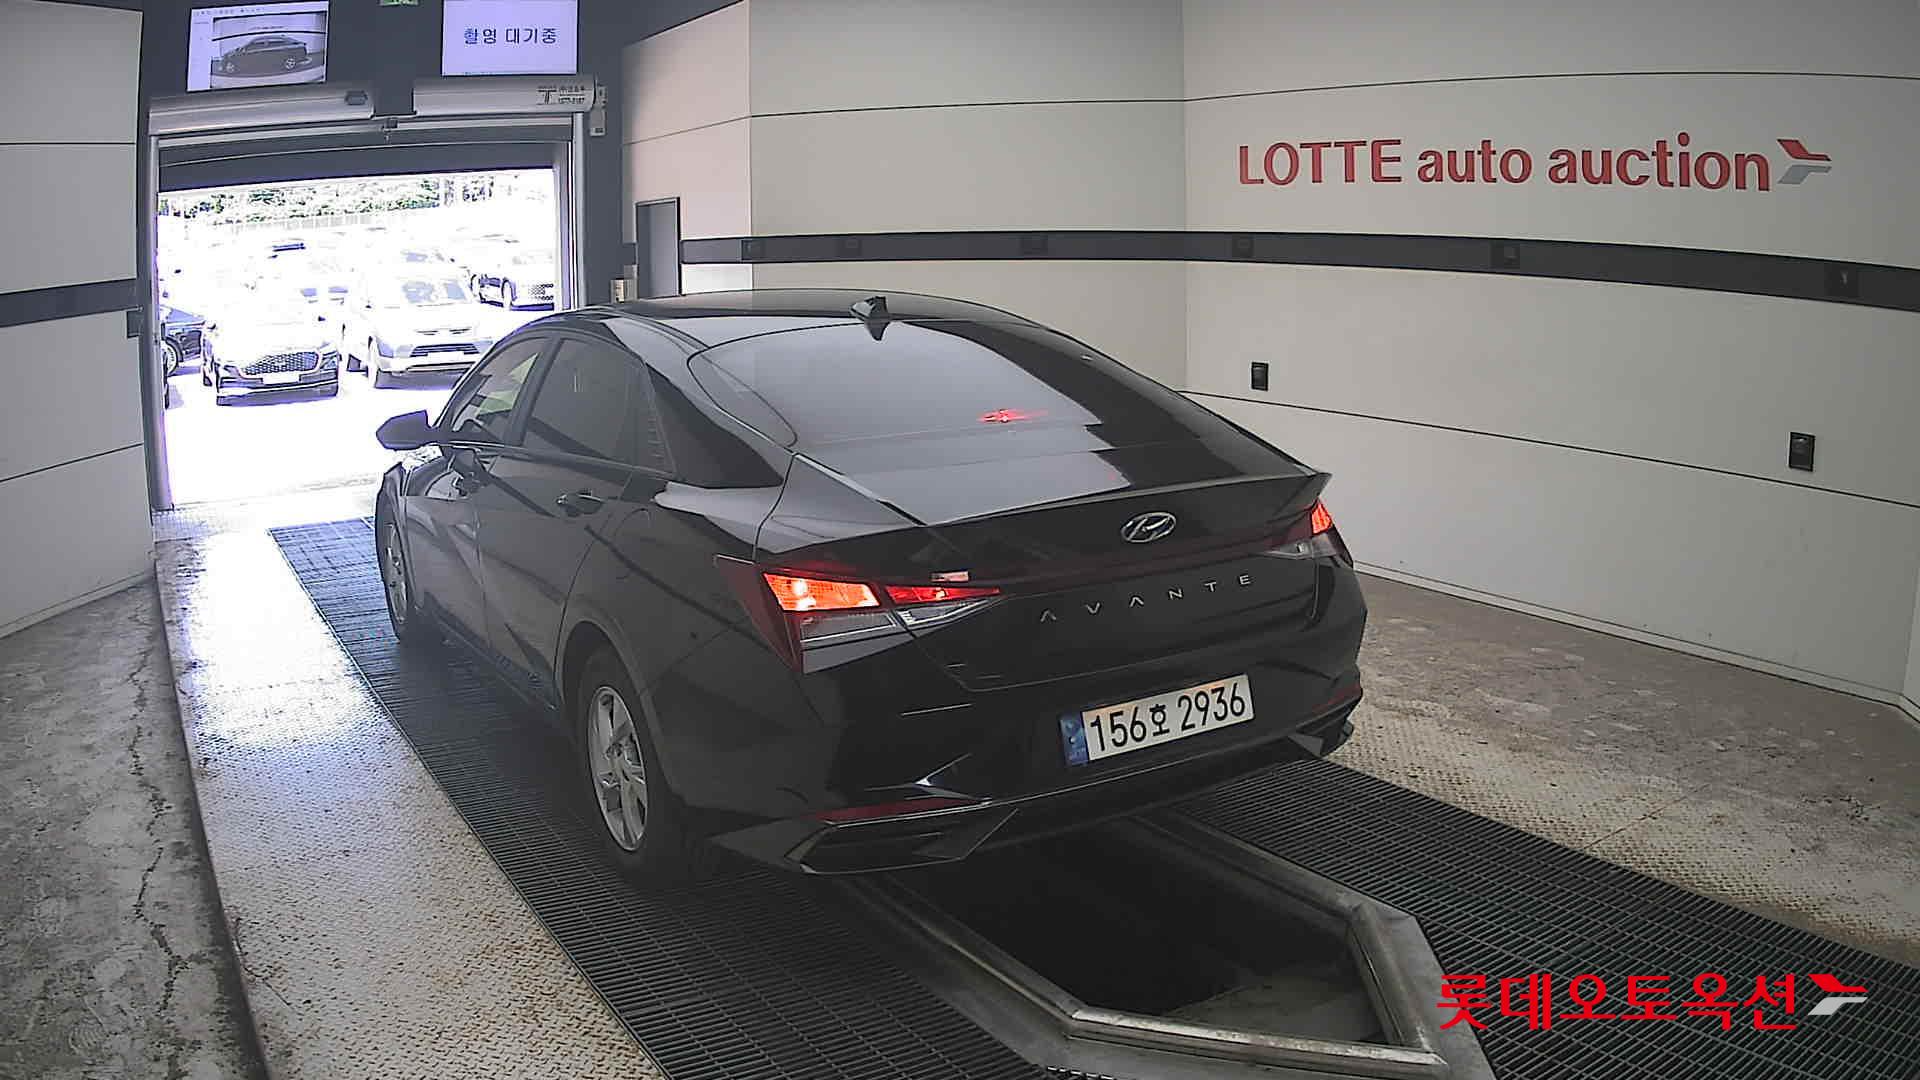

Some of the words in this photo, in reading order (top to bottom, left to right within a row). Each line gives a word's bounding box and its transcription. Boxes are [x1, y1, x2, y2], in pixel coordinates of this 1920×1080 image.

[505, 27, 557, 45] 대기중
[1239, 138, 1402, 186] LOTTE
[1416, 139, 1533, 184] auto
[1547, 131, 1771, 192] auction
[1040, 573, 1252, 623] AVANTE
[1089, 702, 1171, 752] 156호
[1177, 681, 1246, 733] 2936
